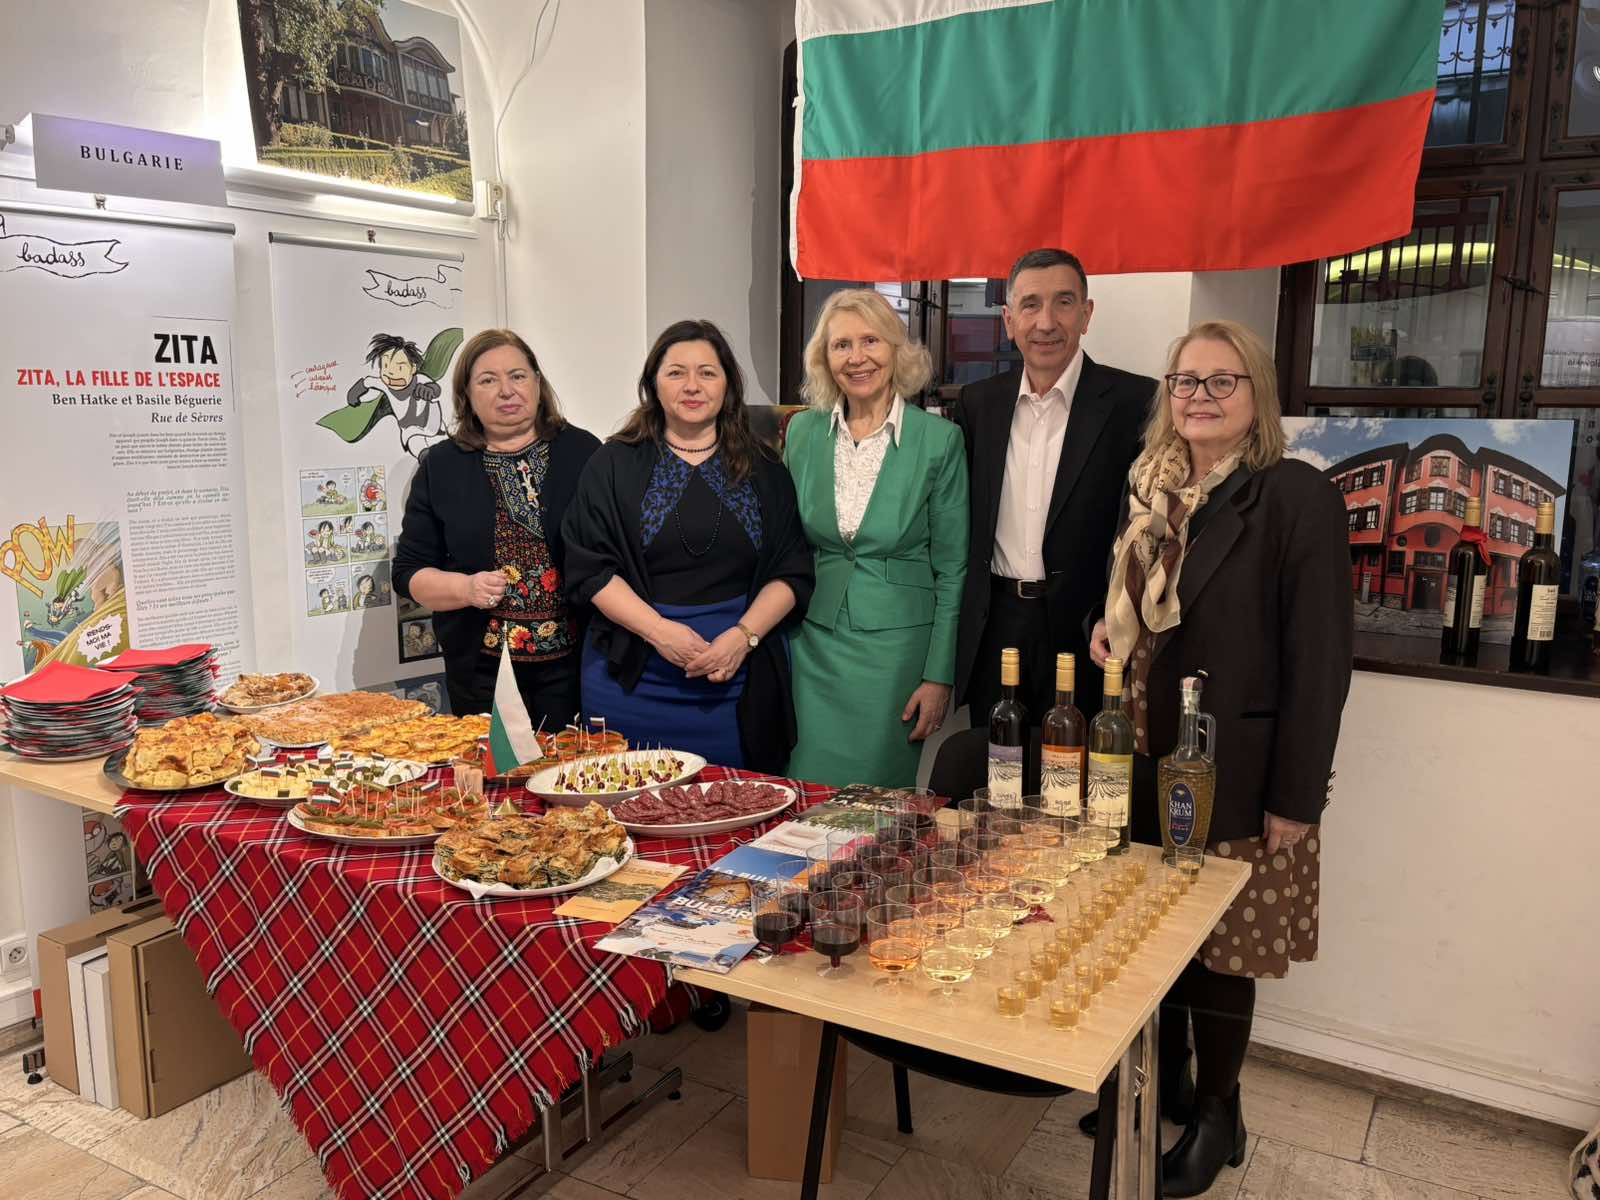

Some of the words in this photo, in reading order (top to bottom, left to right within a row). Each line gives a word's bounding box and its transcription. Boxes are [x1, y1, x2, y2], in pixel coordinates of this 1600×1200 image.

[80, 145, 184, 171] BULGARIE
[16, 241, 86, 267] badass
[384, 280, 427, 299] badass
[153, 333, 218, 365] ZITA
[17, 369, 60, 387] ZITA,
[65, 370, 86, 386] LA
[92, 370, 130, 387] FILLE
[135, 371, 153, 387] DE
[158, 372, 221, 387] L'ESPACE
[52, 393, 77, 405] Ben
[81, 394, 118, 405] Hatke
[121, 396, 133, 405] et
[136, 394, 171, 405] Basile
[174, 394, 223, 408] Béguerie
[151, 412, 173, 423] Rue
[175, 412, 188, 423] de
[191, 411, 224, 423] Sèvres
[0, 514, 75, 598] POW
[100, 631, 112, 640] MA
[94, 641, 107, 650] VIE
[1169, 801, 1193, 809] KHAN
[1169, 808, 1193, 817] KRUM
[671, 896, 752, 919] BULGAR
